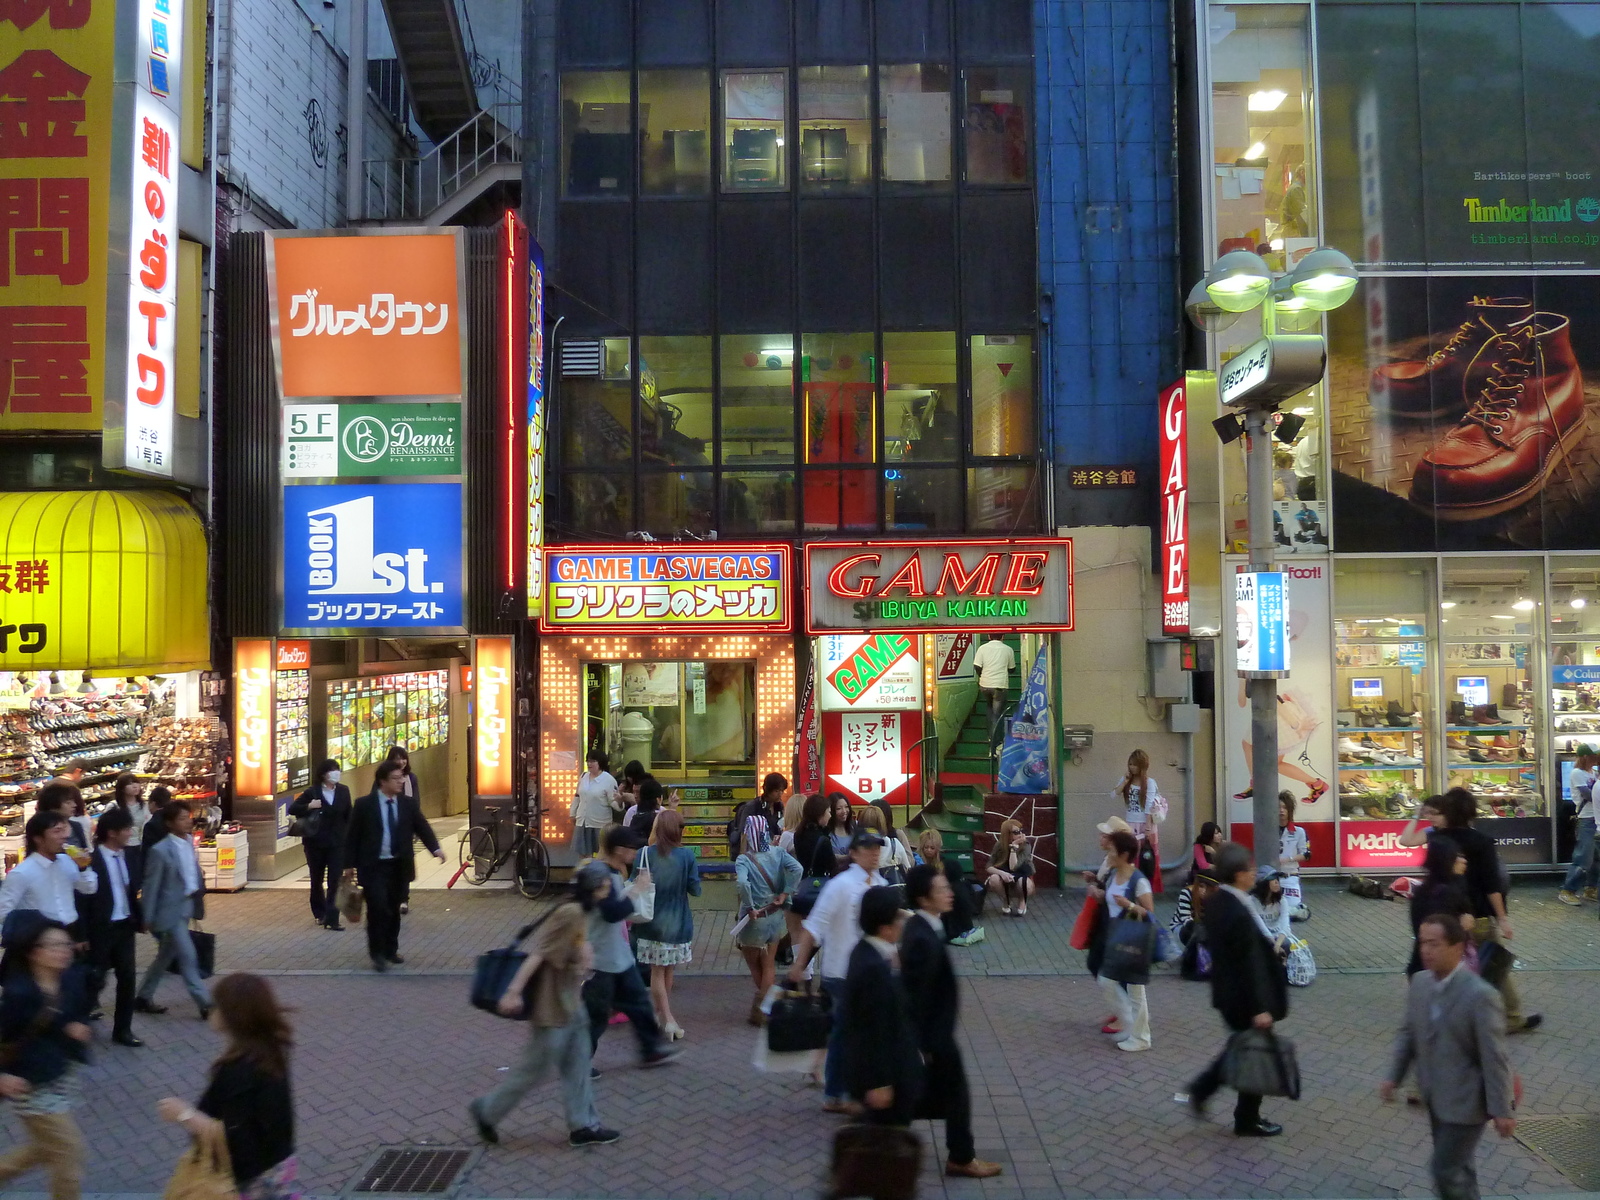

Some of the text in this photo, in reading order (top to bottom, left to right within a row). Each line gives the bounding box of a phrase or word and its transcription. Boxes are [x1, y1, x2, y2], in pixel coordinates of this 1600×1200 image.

[1566, 172, 1591, 180] boot
[0, 0, 92, 416] 金問屋
[1464, 198, 1572, 222] Timberland
[1471, 233, 1600, 245] timberland.co.jp
[290, 289, 448, 337] グルメタウン
[1222, 348, 1268, 393] 渋谷センター街
[390, 422, 455, 447] Demi
[390, 447, 455, 455] RENAISSANCE
[1073, 470, 1136, 485] 渋谷会館
[1164, 386, 1187, 595] GAME
[309, 518, 333, 586] BOOK
[557, 556, 771, 581] GAME LASVEGAS
[827, 550, 1050, 598] GAME
[307, 602, 444, 621] ブックファースト
[555, 584, 777, 618] プリクラのメッカ
[853, 600, 1027, 620] SHIBUYA KAIKAN
[1164, 601, 1188, 626] 渋谷会館
[278, 647, 307, 663] グルメタウン
[828, 641, 844, 650] 3F
[828, 651, 844, 660] 2F
[835, 635, 911, 699] GAME
[864, 723, 878, 758] マシン
[881, 714, 895, 751] 新しい
